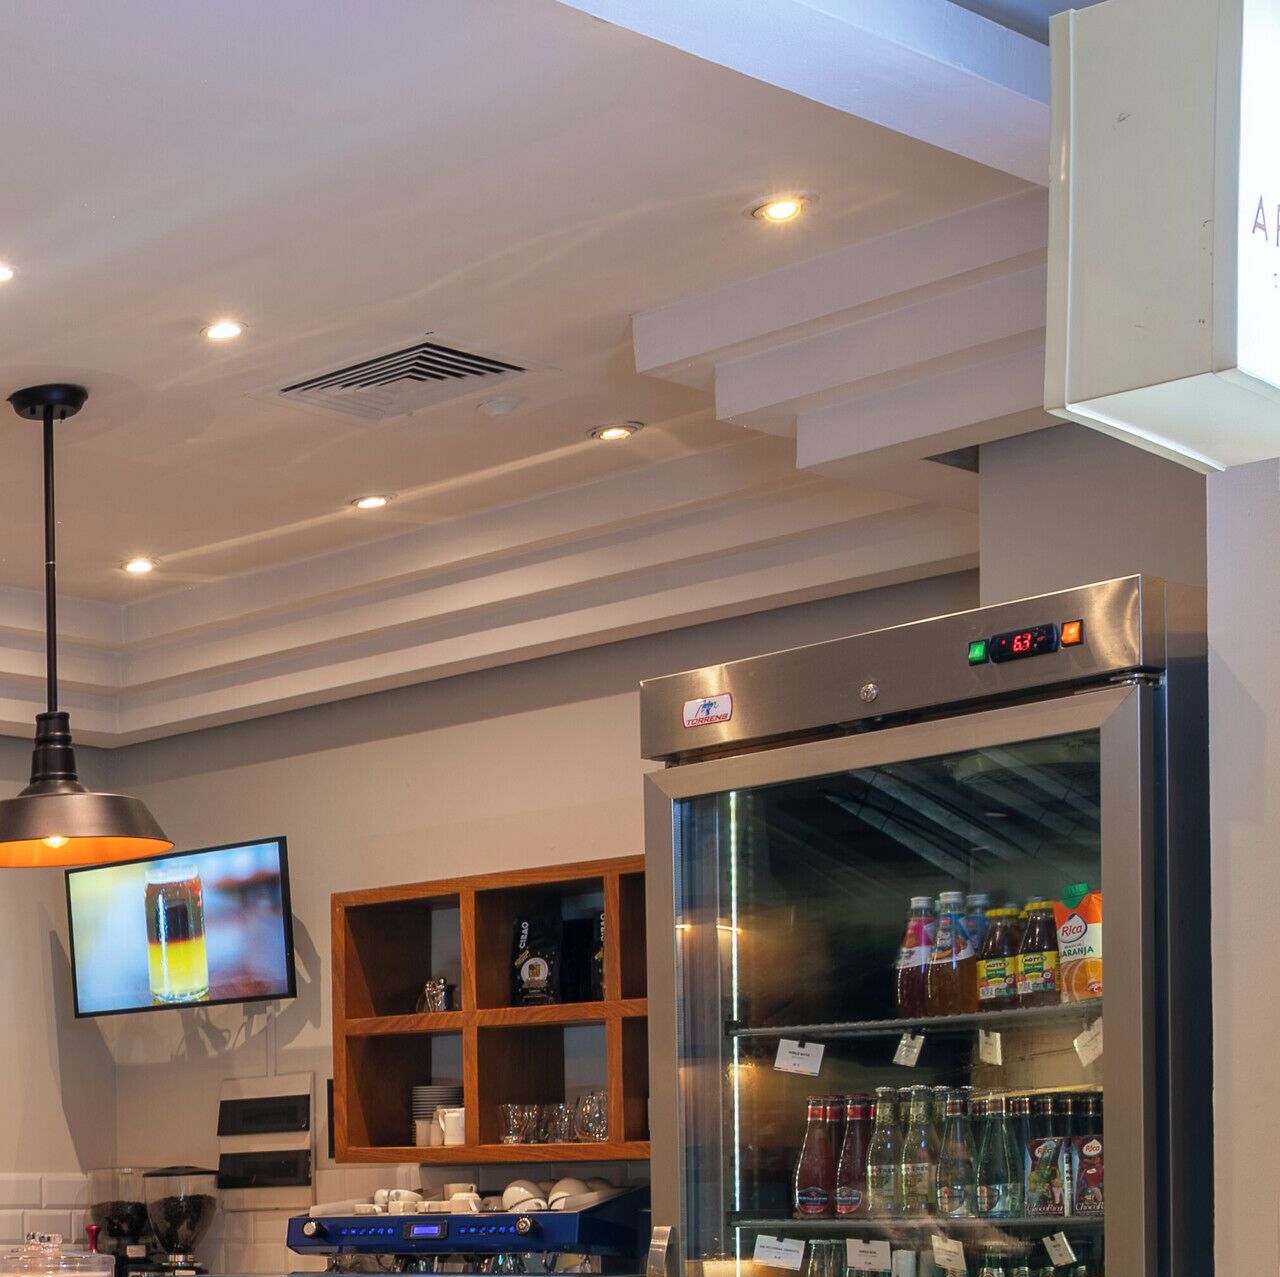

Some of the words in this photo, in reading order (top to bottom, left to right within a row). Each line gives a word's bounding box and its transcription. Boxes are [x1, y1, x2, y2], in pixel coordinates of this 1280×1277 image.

[519, 921, 529, 949] CIBAO
[1061, 924, 1083, 938] Rica
[1061, 944, 1094, 958] ARANJA
[1085, 1144, 1100, 1153] Rica
[1075, 1201, 1104, 1212] ChocoR
